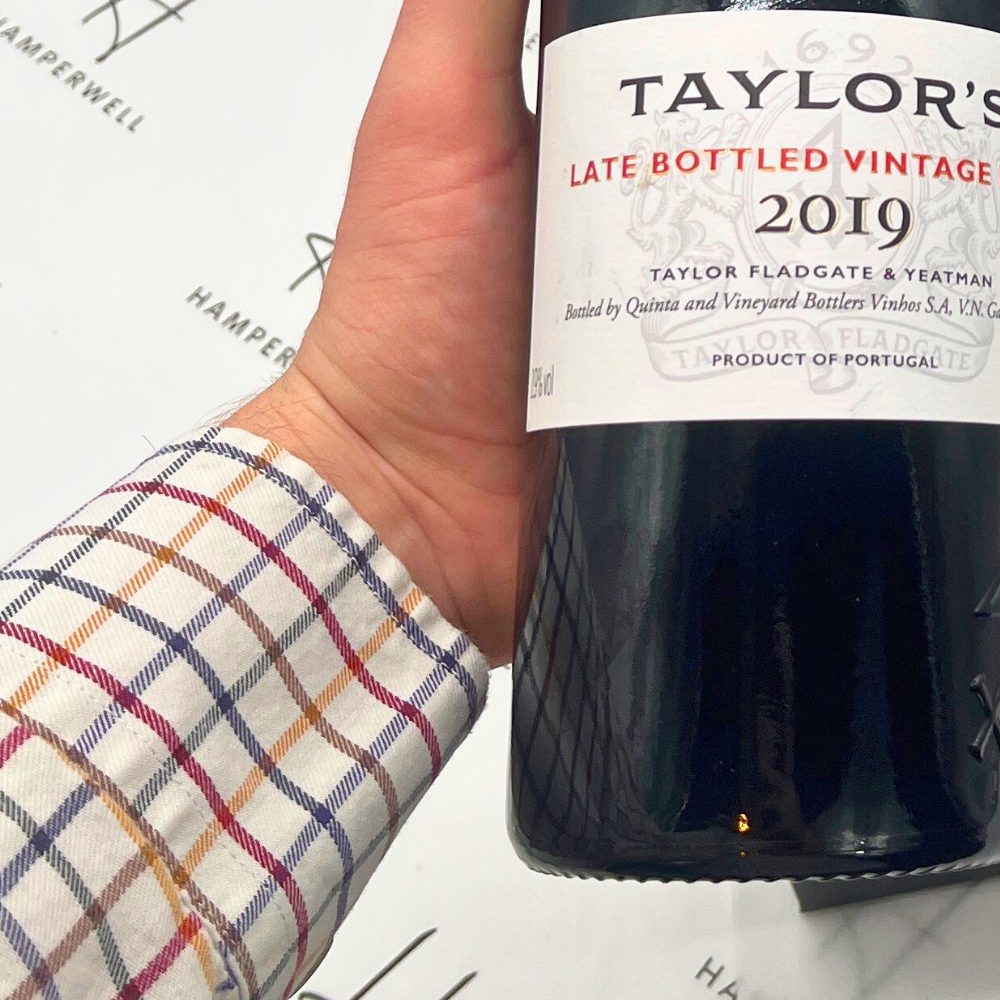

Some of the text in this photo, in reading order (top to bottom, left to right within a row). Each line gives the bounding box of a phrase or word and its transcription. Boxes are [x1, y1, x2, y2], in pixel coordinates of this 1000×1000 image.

[570, 154, 637, 188] LATE
[651, 147, 829, 175] BOTTLED
[843, 149, 991, 186] VINTAGE
[754, 193, 914, 251] 2019
[649, 264, 993, 289] TAYLOR FLADGATE & YEATMAN
[564, 299, 604, 322] Bottled
[606, 298, 623, 322] by
[625, 294, 681, 319] Quinta
[684, 292, 720, 312] and
[723, 290, 800, 316] Vineyard
[803, 291, 866, 312] Bottlers
[870, 293, 922, 314] Vinhos
[958, 298, 985, 319] V.N.
[712, 352, 940, 370] PRODUCT OF PORTUGAL
